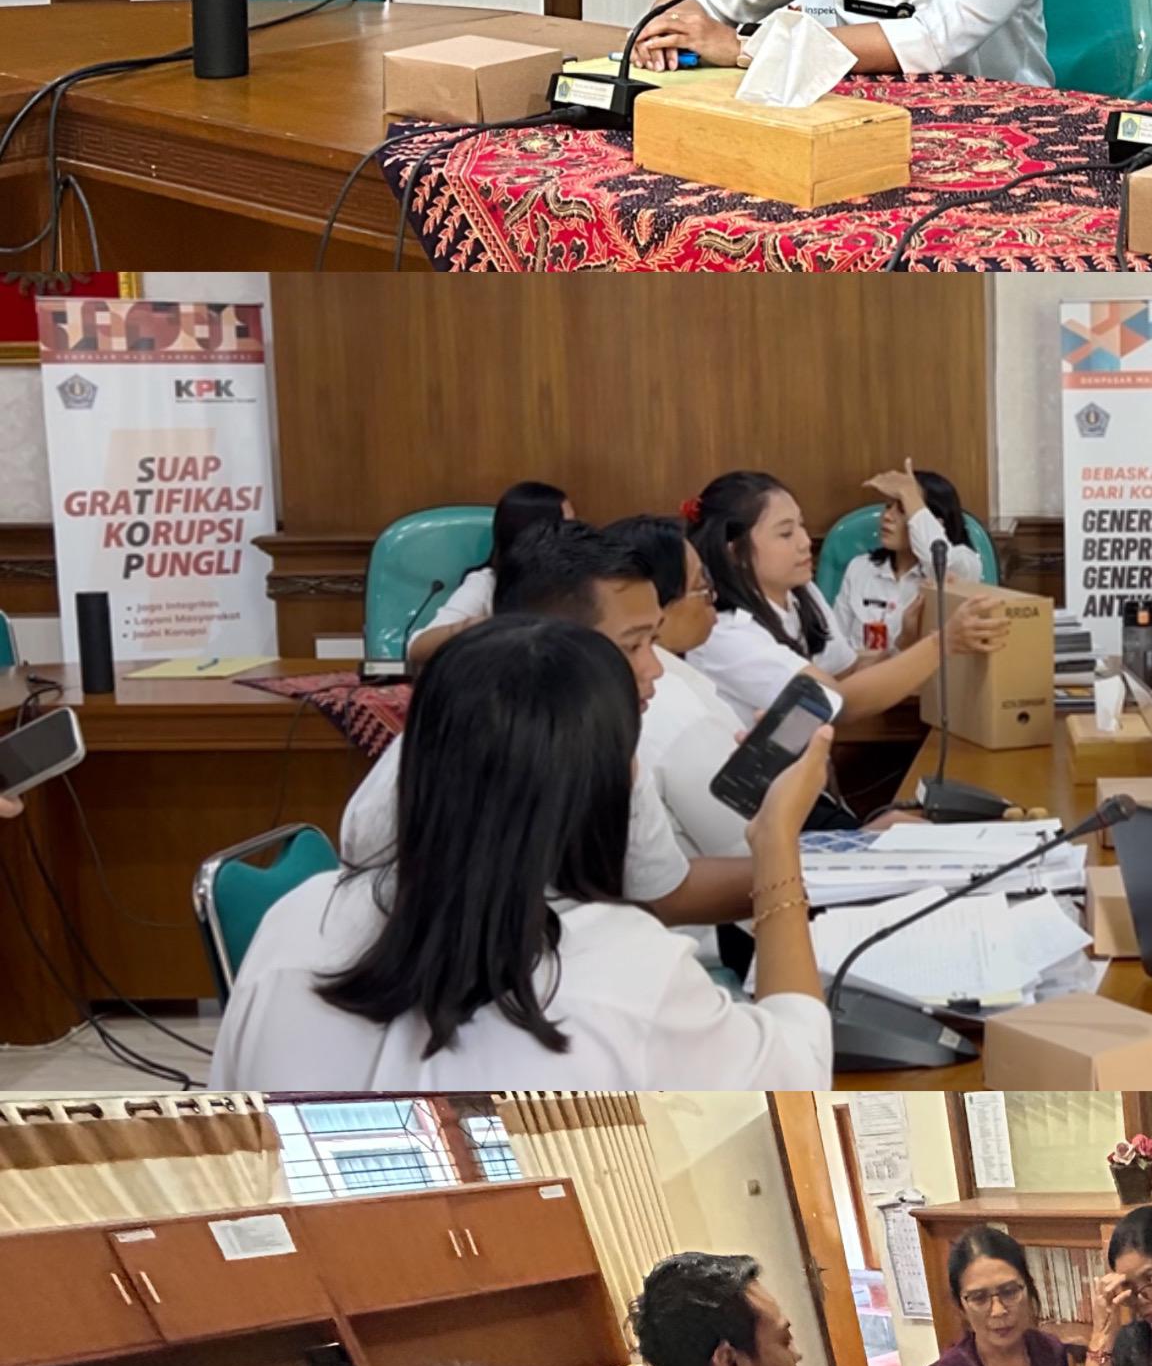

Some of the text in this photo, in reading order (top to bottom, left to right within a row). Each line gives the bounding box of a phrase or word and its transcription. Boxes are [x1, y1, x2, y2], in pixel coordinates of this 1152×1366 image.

[175, 379, 234, 398] KPK
[137, 455, 222, 483] SUAP
[64, 486, 263, 518] GRATIFIKASI
[1081, 485, 1124, 500] DARI
[103, 518, 244, 549] KORUPSI
[122, 549, 243, 580] PUNGLI
